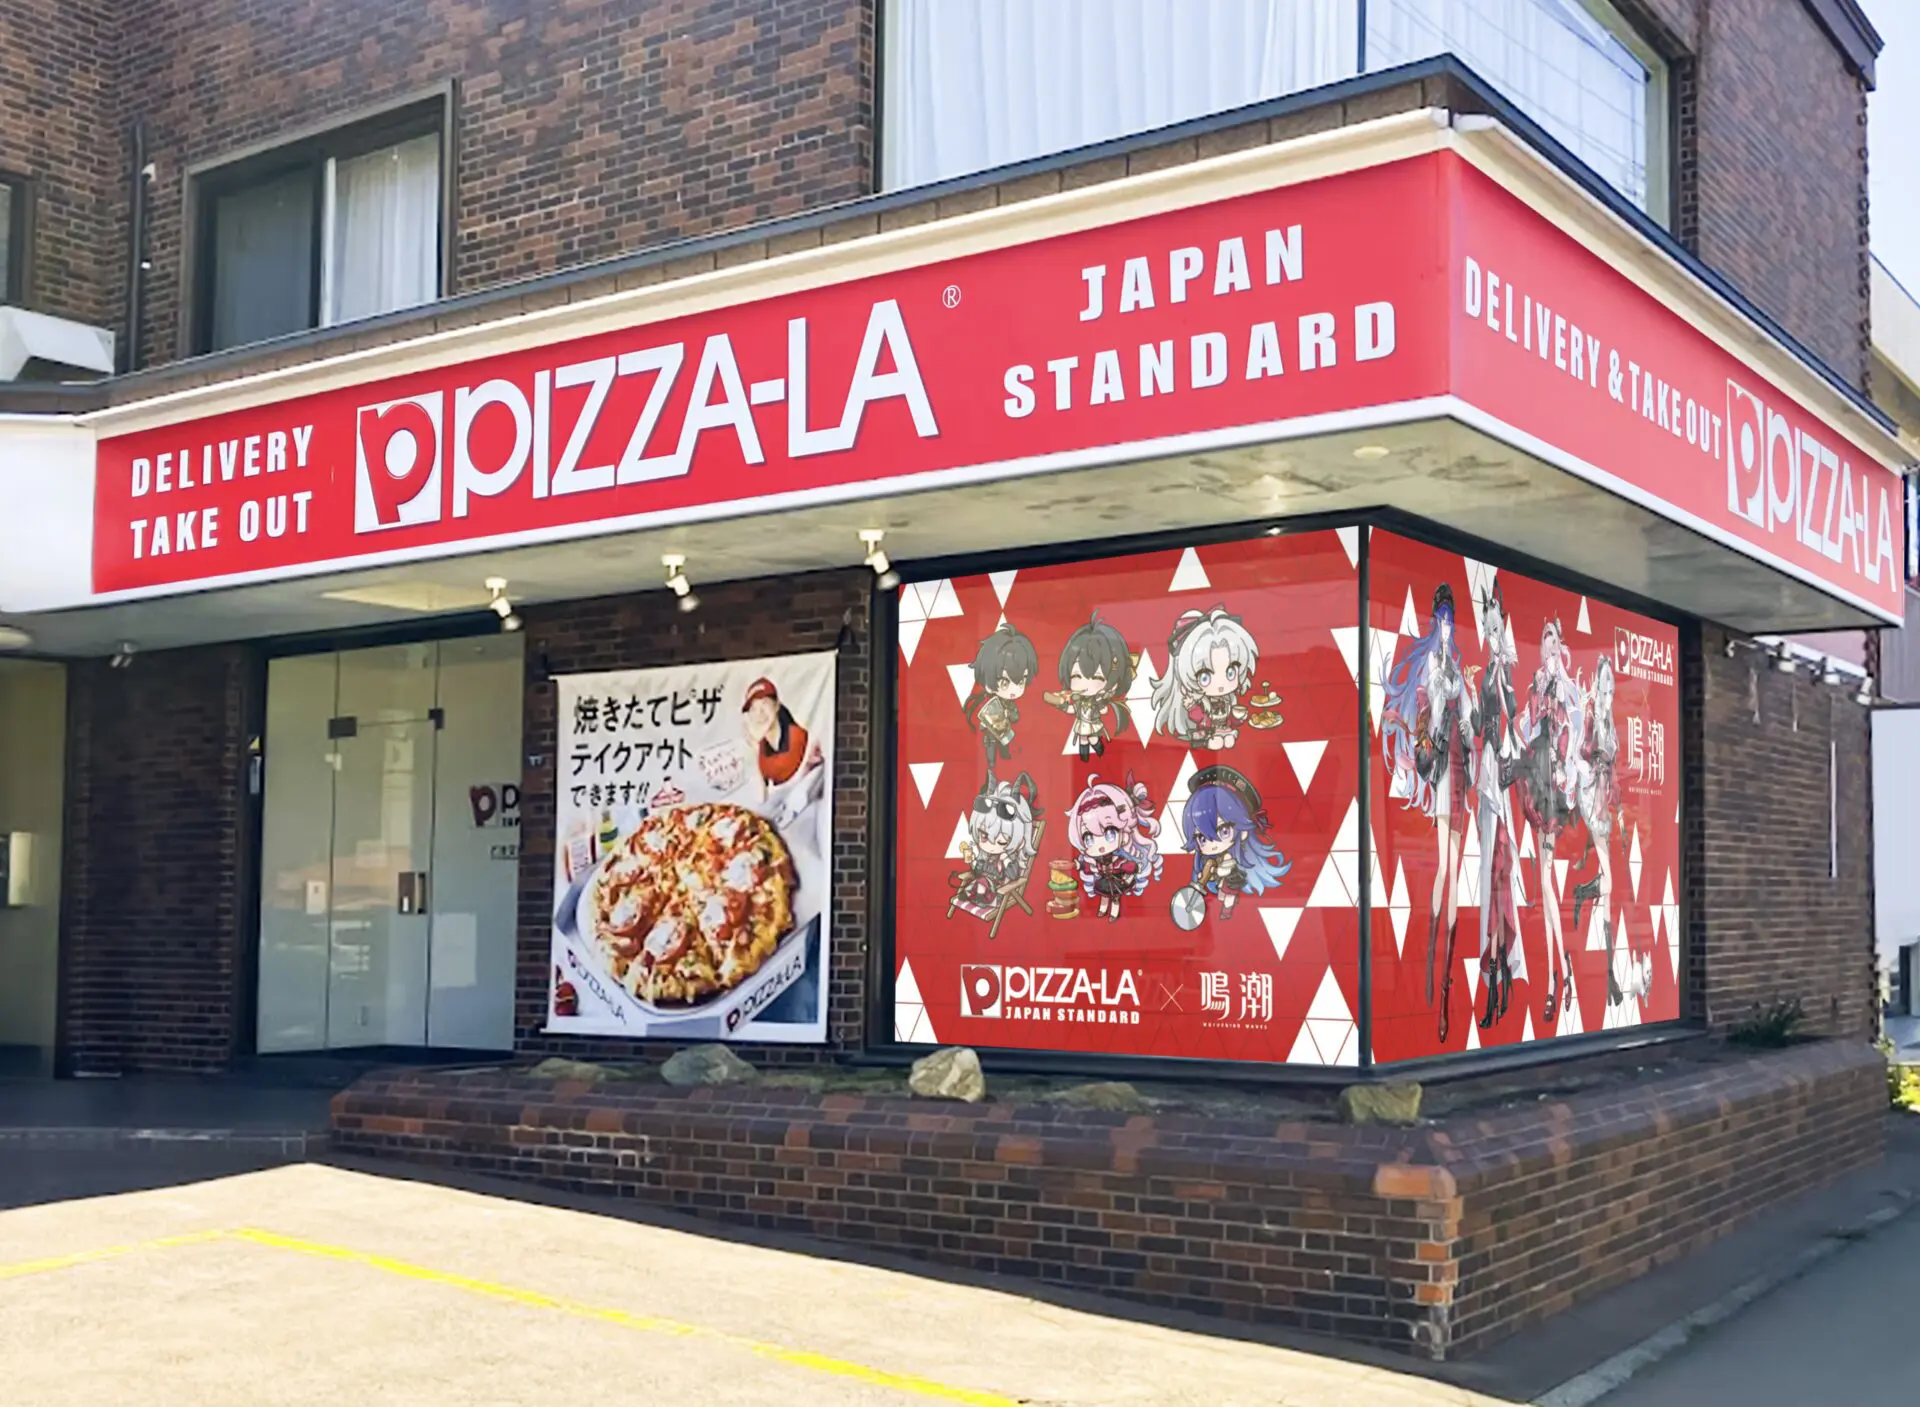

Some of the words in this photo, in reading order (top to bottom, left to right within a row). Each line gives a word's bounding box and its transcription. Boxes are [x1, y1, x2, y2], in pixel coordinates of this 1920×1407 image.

[1080, 224, 1302, 322] JAPAN
[1004, 301, 1396, 419] STANDARD
[1465, 256, 1601, 389] DELIVERY
[1608, 348, 1624, 404] &
[131, 424, 314, 498] DELIVERY
[131, 507, 219, 559] TAKE
[239, 491, 313, 542] OUT
[573, 684, 725, 735] 焼きたてピザ
[570, 738, 693, 776] テイクアウト
[1005, 1006, 1051, 1021] JAPAN
[1057, 1008, 1140, 1025] STANDARD
